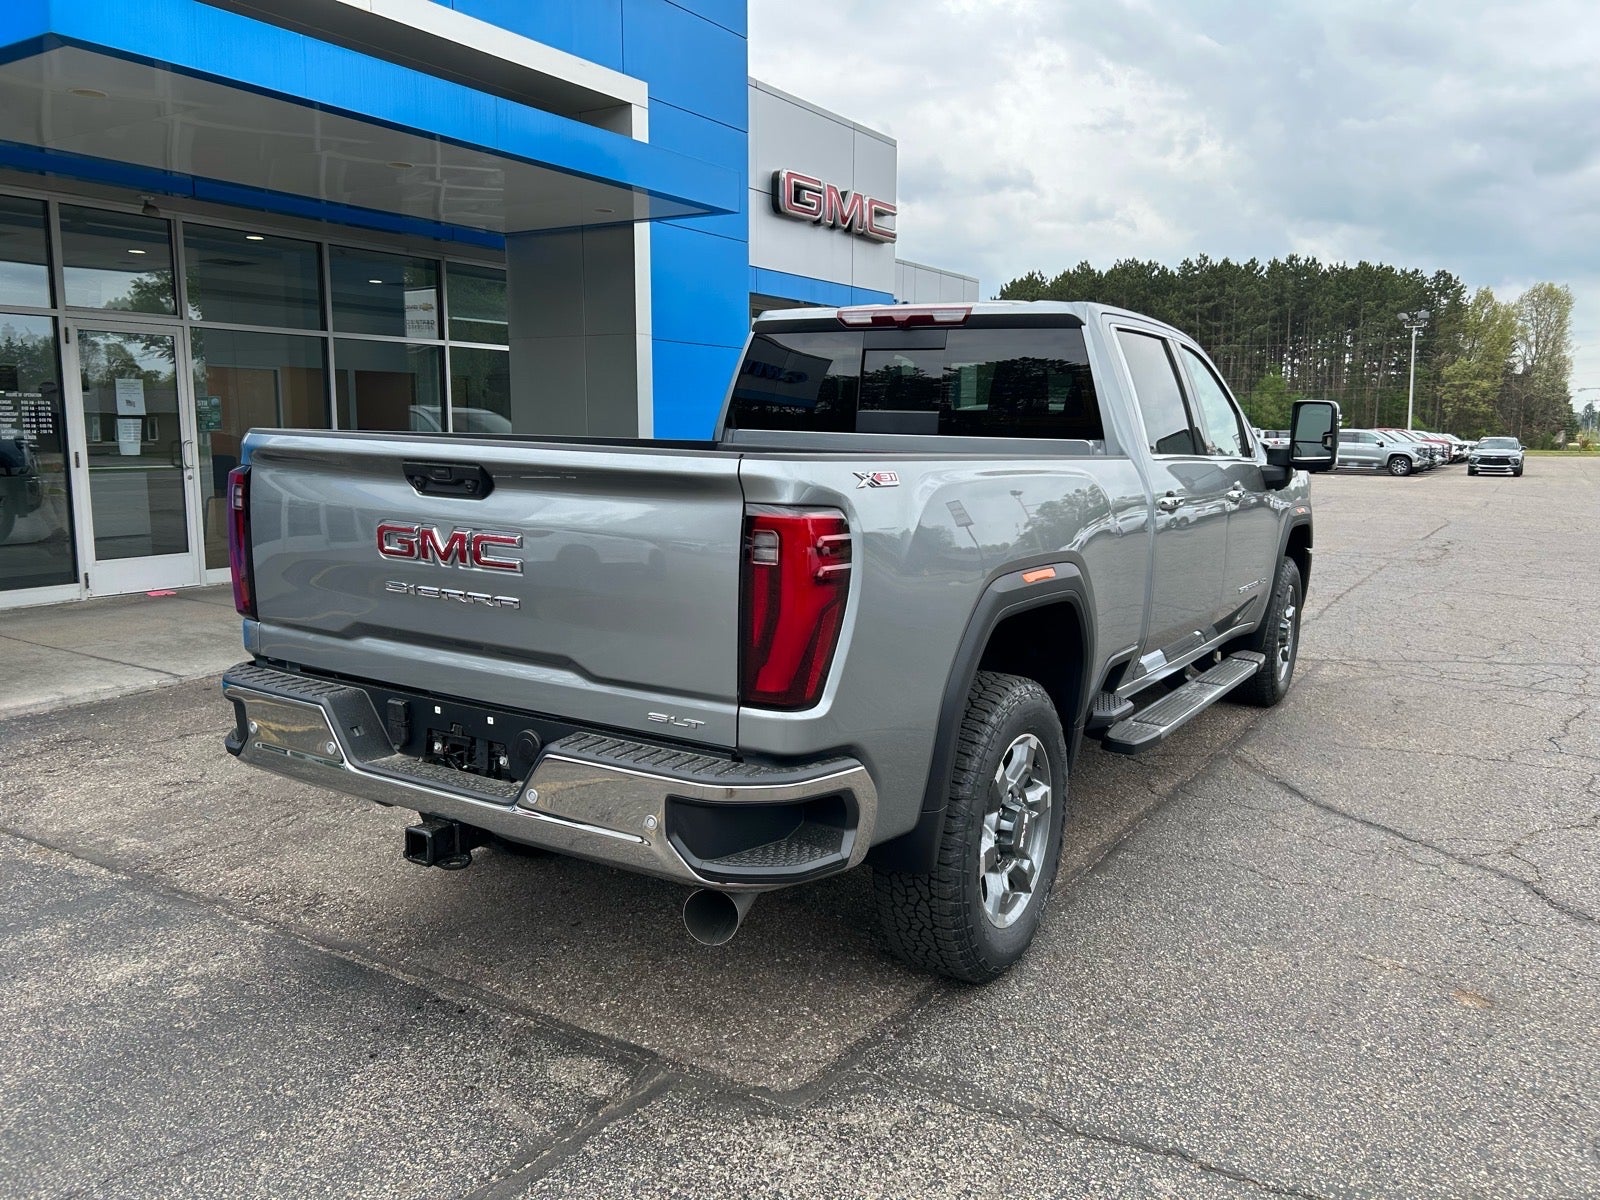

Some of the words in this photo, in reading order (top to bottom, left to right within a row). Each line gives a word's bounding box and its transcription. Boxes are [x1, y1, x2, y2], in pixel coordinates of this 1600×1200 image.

[773, 168, 898, 244] GMC
[376, 520, 524, 576] GMC
[385, 580, 521, 610] SIERRA
[647, 711, 706, 729] SLT
